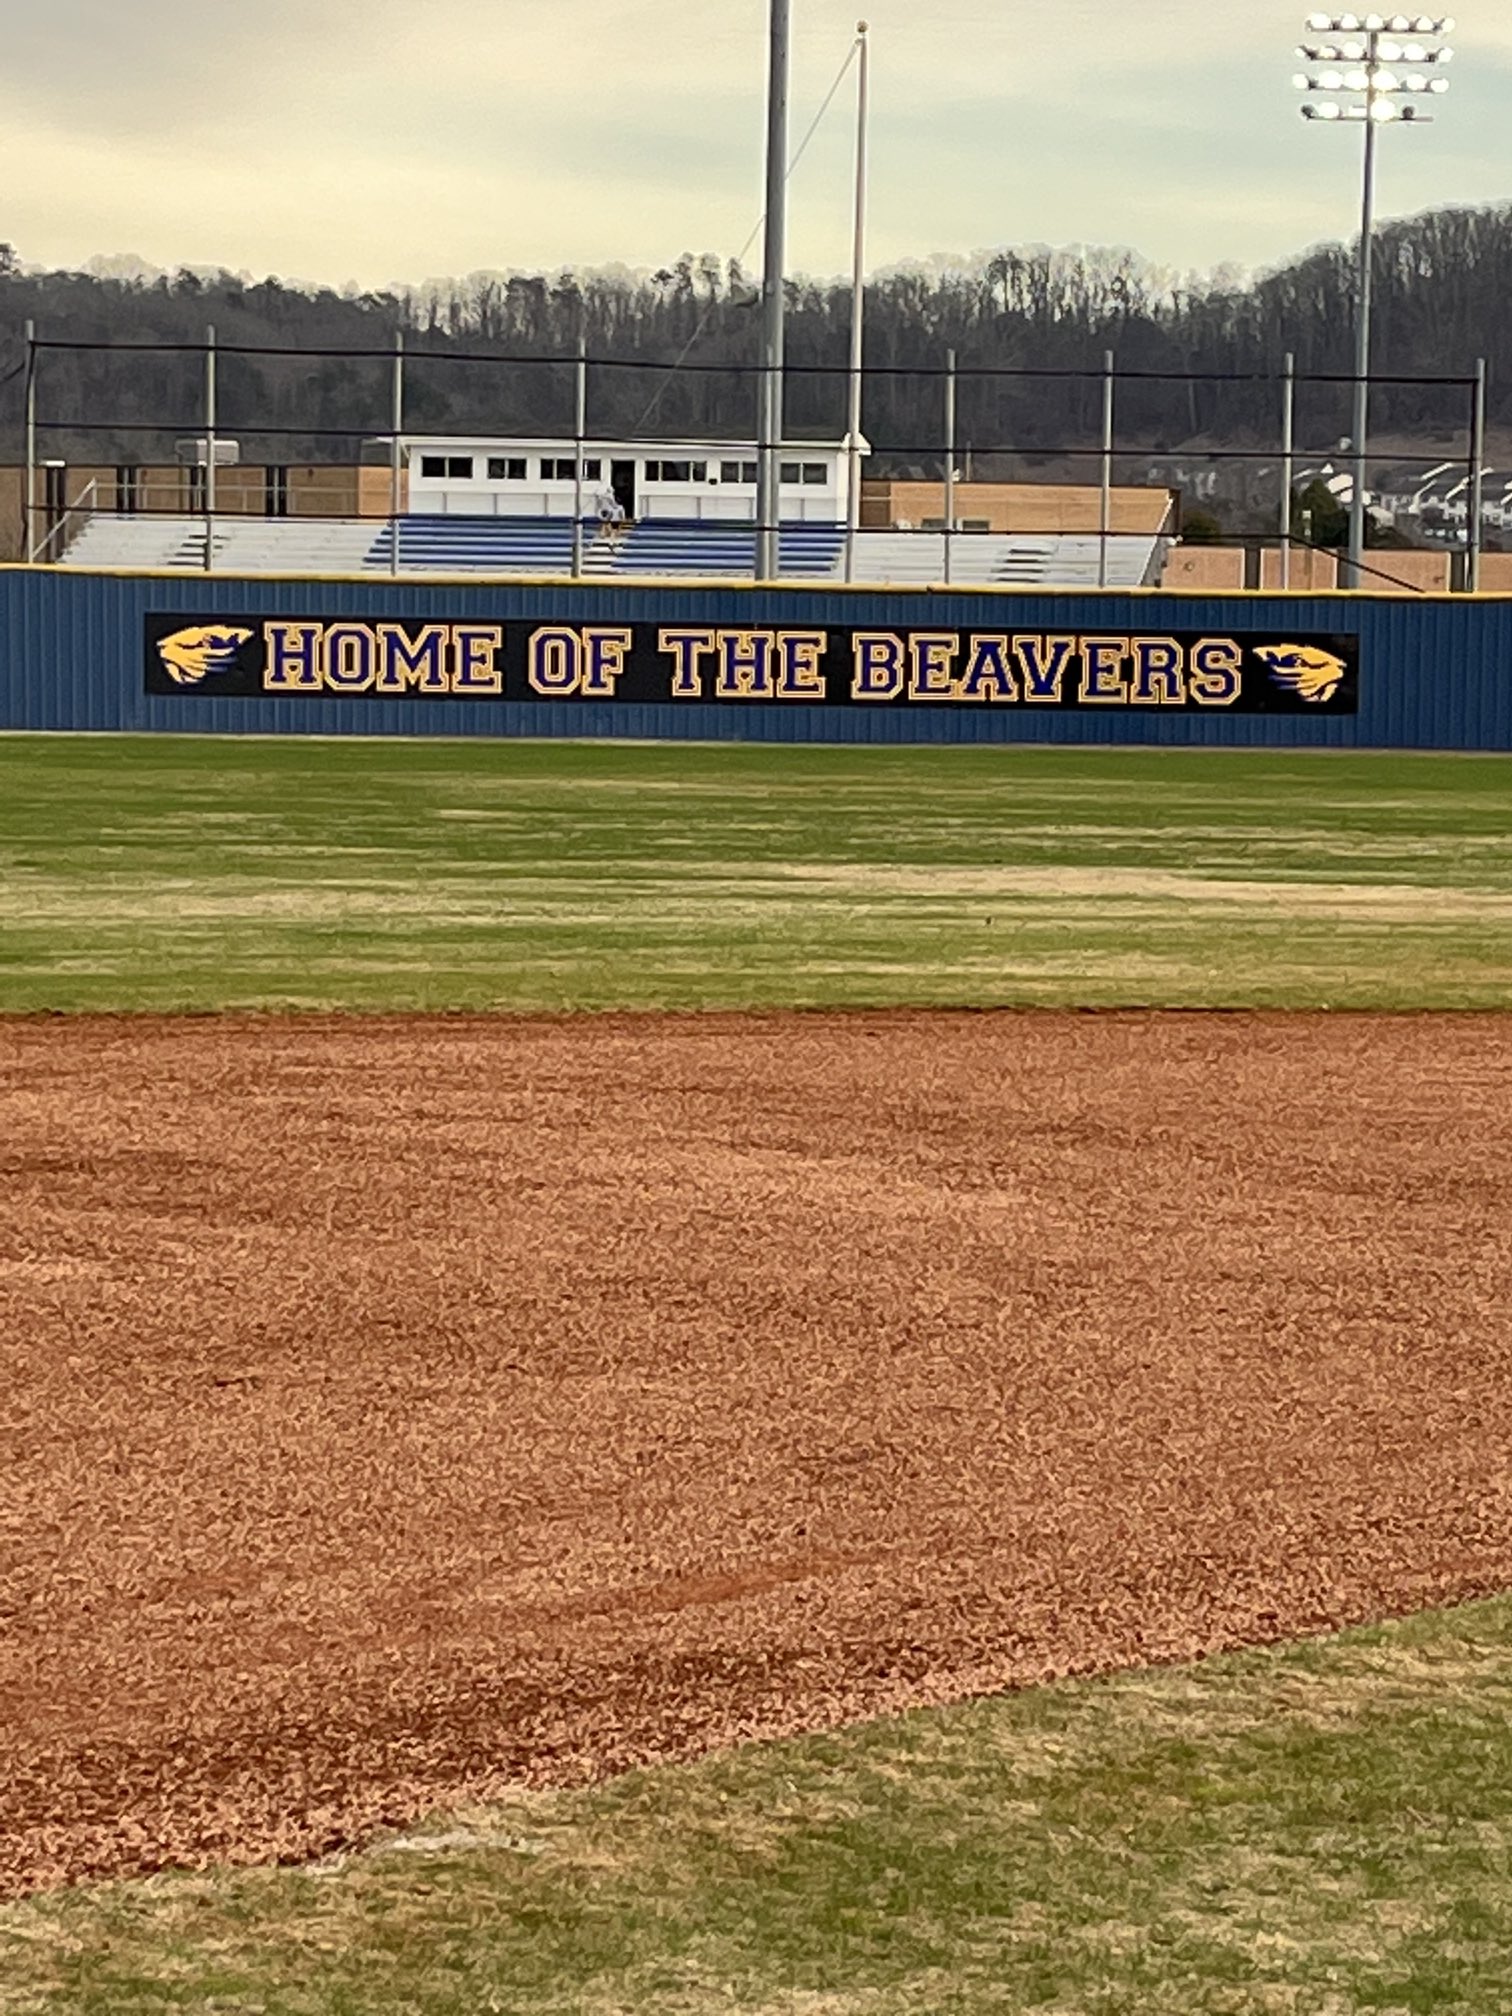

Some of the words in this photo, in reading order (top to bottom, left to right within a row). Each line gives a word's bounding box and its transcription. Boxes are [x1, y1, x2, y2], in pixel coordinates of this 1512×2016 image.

[262, 621, 502, 694] HOME
[527, 626, 632, 696] OF
[657, 628, 827, 700] THE
[850, 631, 1243, 706] BEAVERS
